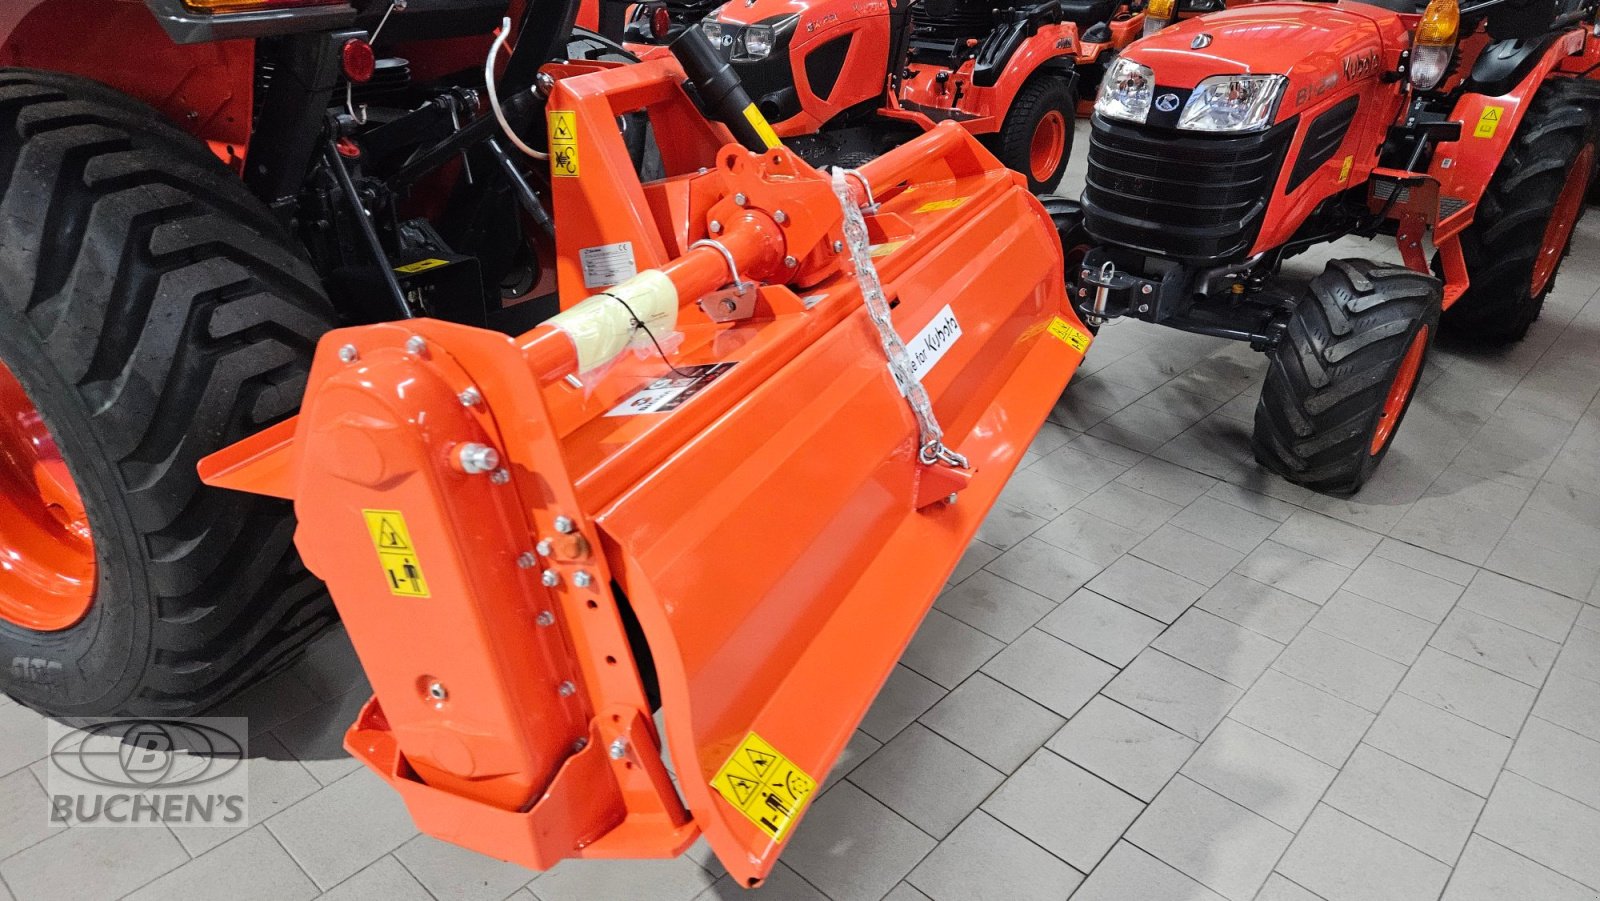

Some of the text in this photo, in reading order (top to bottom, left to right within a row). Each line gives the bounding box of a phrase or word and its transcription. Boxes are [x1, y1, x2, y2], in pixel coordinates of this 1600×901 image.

[1343, 49, 1379, 81] Kubota
[915, 349, 928, 365] for
[924, 317, 957, 351] Kubota
